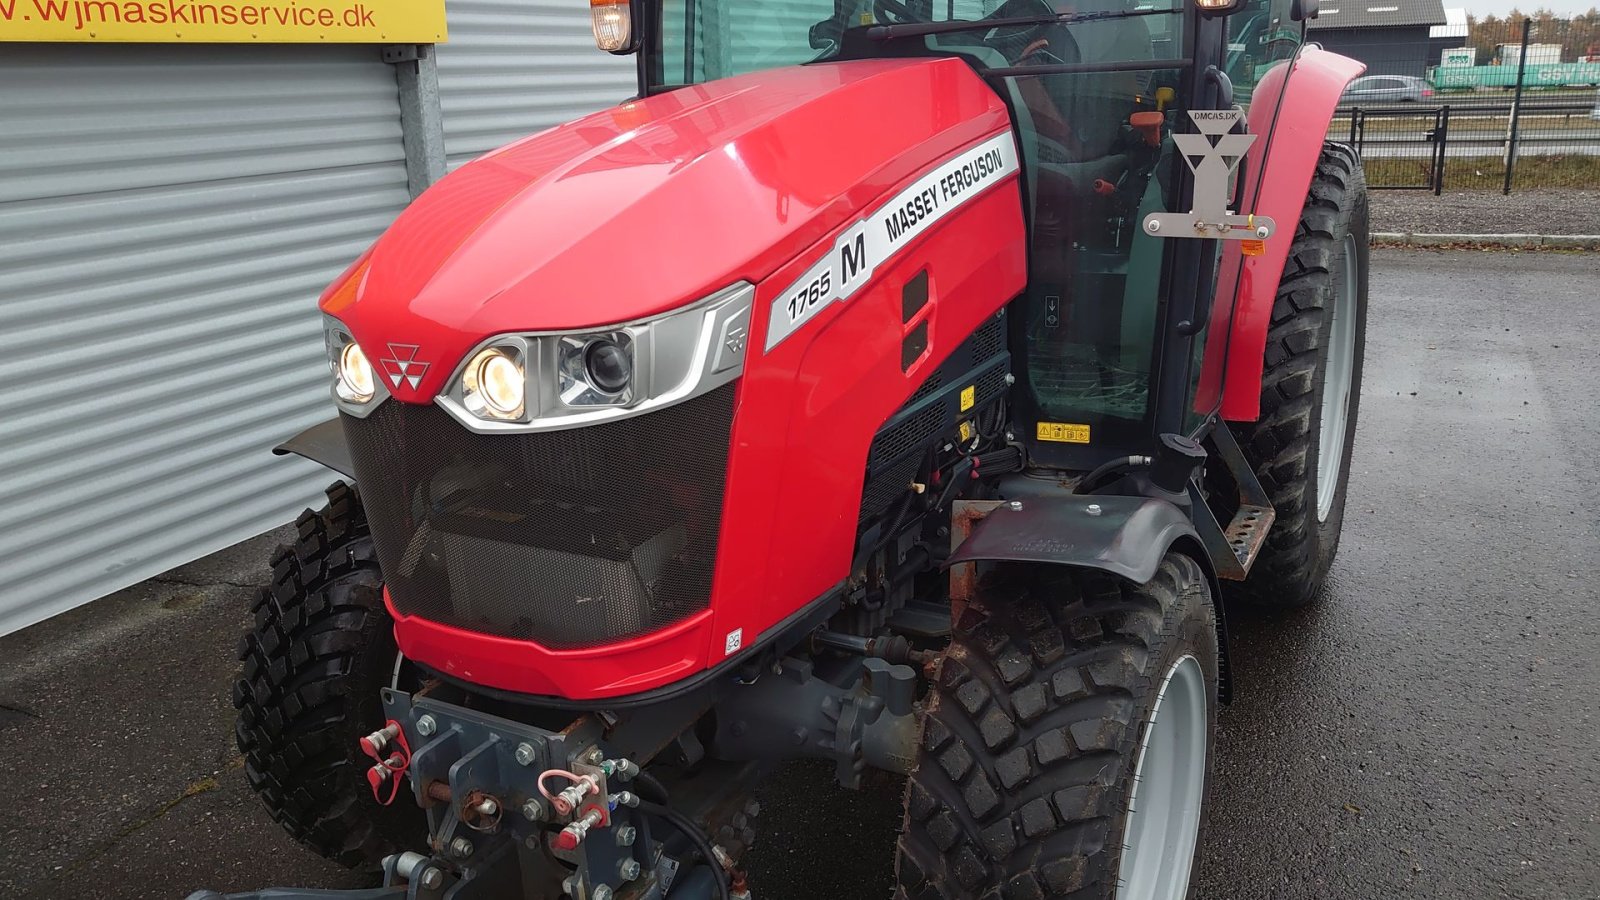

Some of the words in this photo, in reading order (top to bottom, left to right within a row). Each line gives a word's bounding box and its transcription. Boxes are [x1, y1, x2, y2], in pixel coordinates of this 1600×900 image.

[1194, 112, 1237, 121] DMCAS.DK
[788, 271, 831, 319] 1765
[841, 232, 866, 285] M
[885, 184, 939, 243] MASSEY
[940, 147, 1003, 203] FERGUSON
